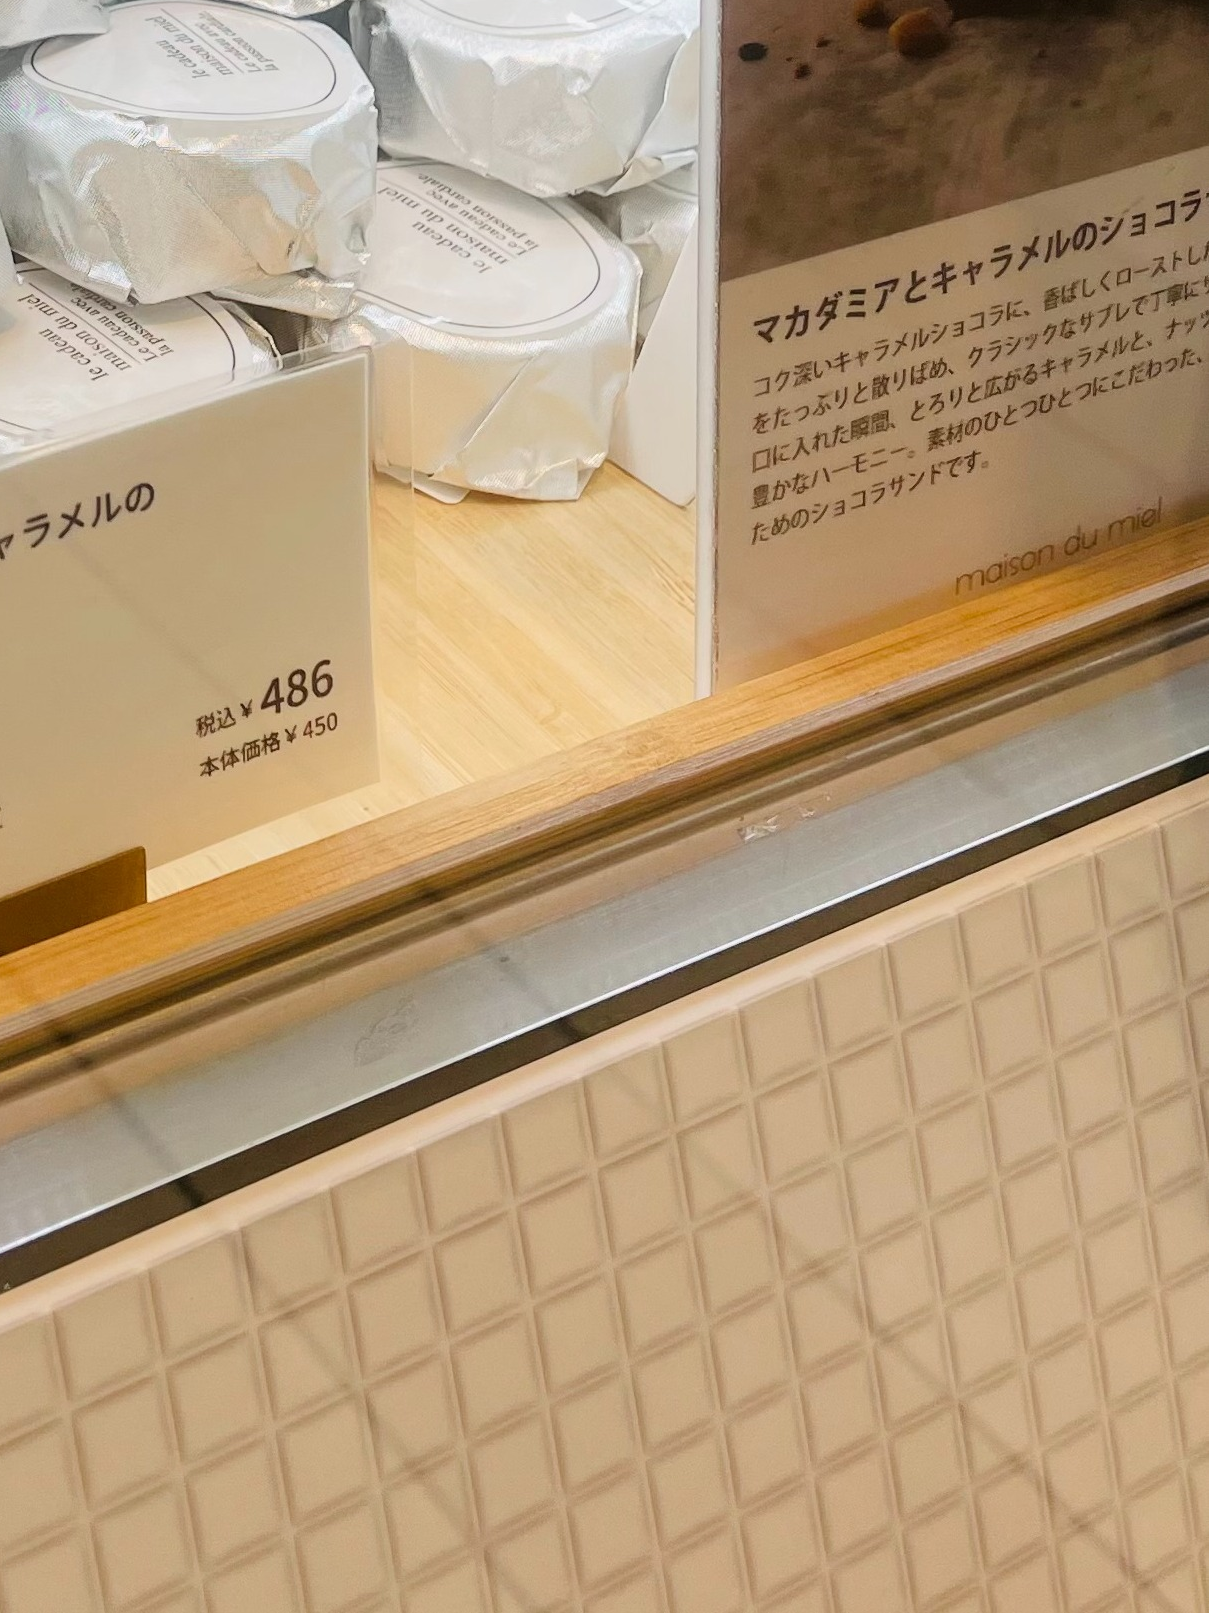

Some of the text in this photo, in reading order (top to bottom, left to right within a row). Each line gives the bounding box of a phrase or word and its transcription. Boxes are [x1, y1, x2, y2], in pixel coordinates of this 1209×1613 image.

[145, 16, 234, 75] maison du miel
[156, 40, 210, 78] le cadeau
[215, 38, 248, 60] cadeau
[245, 62, 262, 73] Le
[377, 187, 510, 264] maison du miel
[412, 221, 492, 273] le cadeau
[426, 190, 528, 255] Le cadeau avec
[473, 206, 527, 239] passion
[525, 239, 539, 250] la
[754, 188, 1209, 343] マカダミアとキャラメルのショコラ
[17, 294, 132, 370] maison du miel
[71, 297, 158, 362] Le cadeau avec
[115, 311, 165, 344] passion
[158, 345, 174, 356] la
[39, 328, 109, 381] le cadeau
[751, 450, 989, 545] ためのショコラサンドです。
[955, 496, 1163, 595] maison du miel
